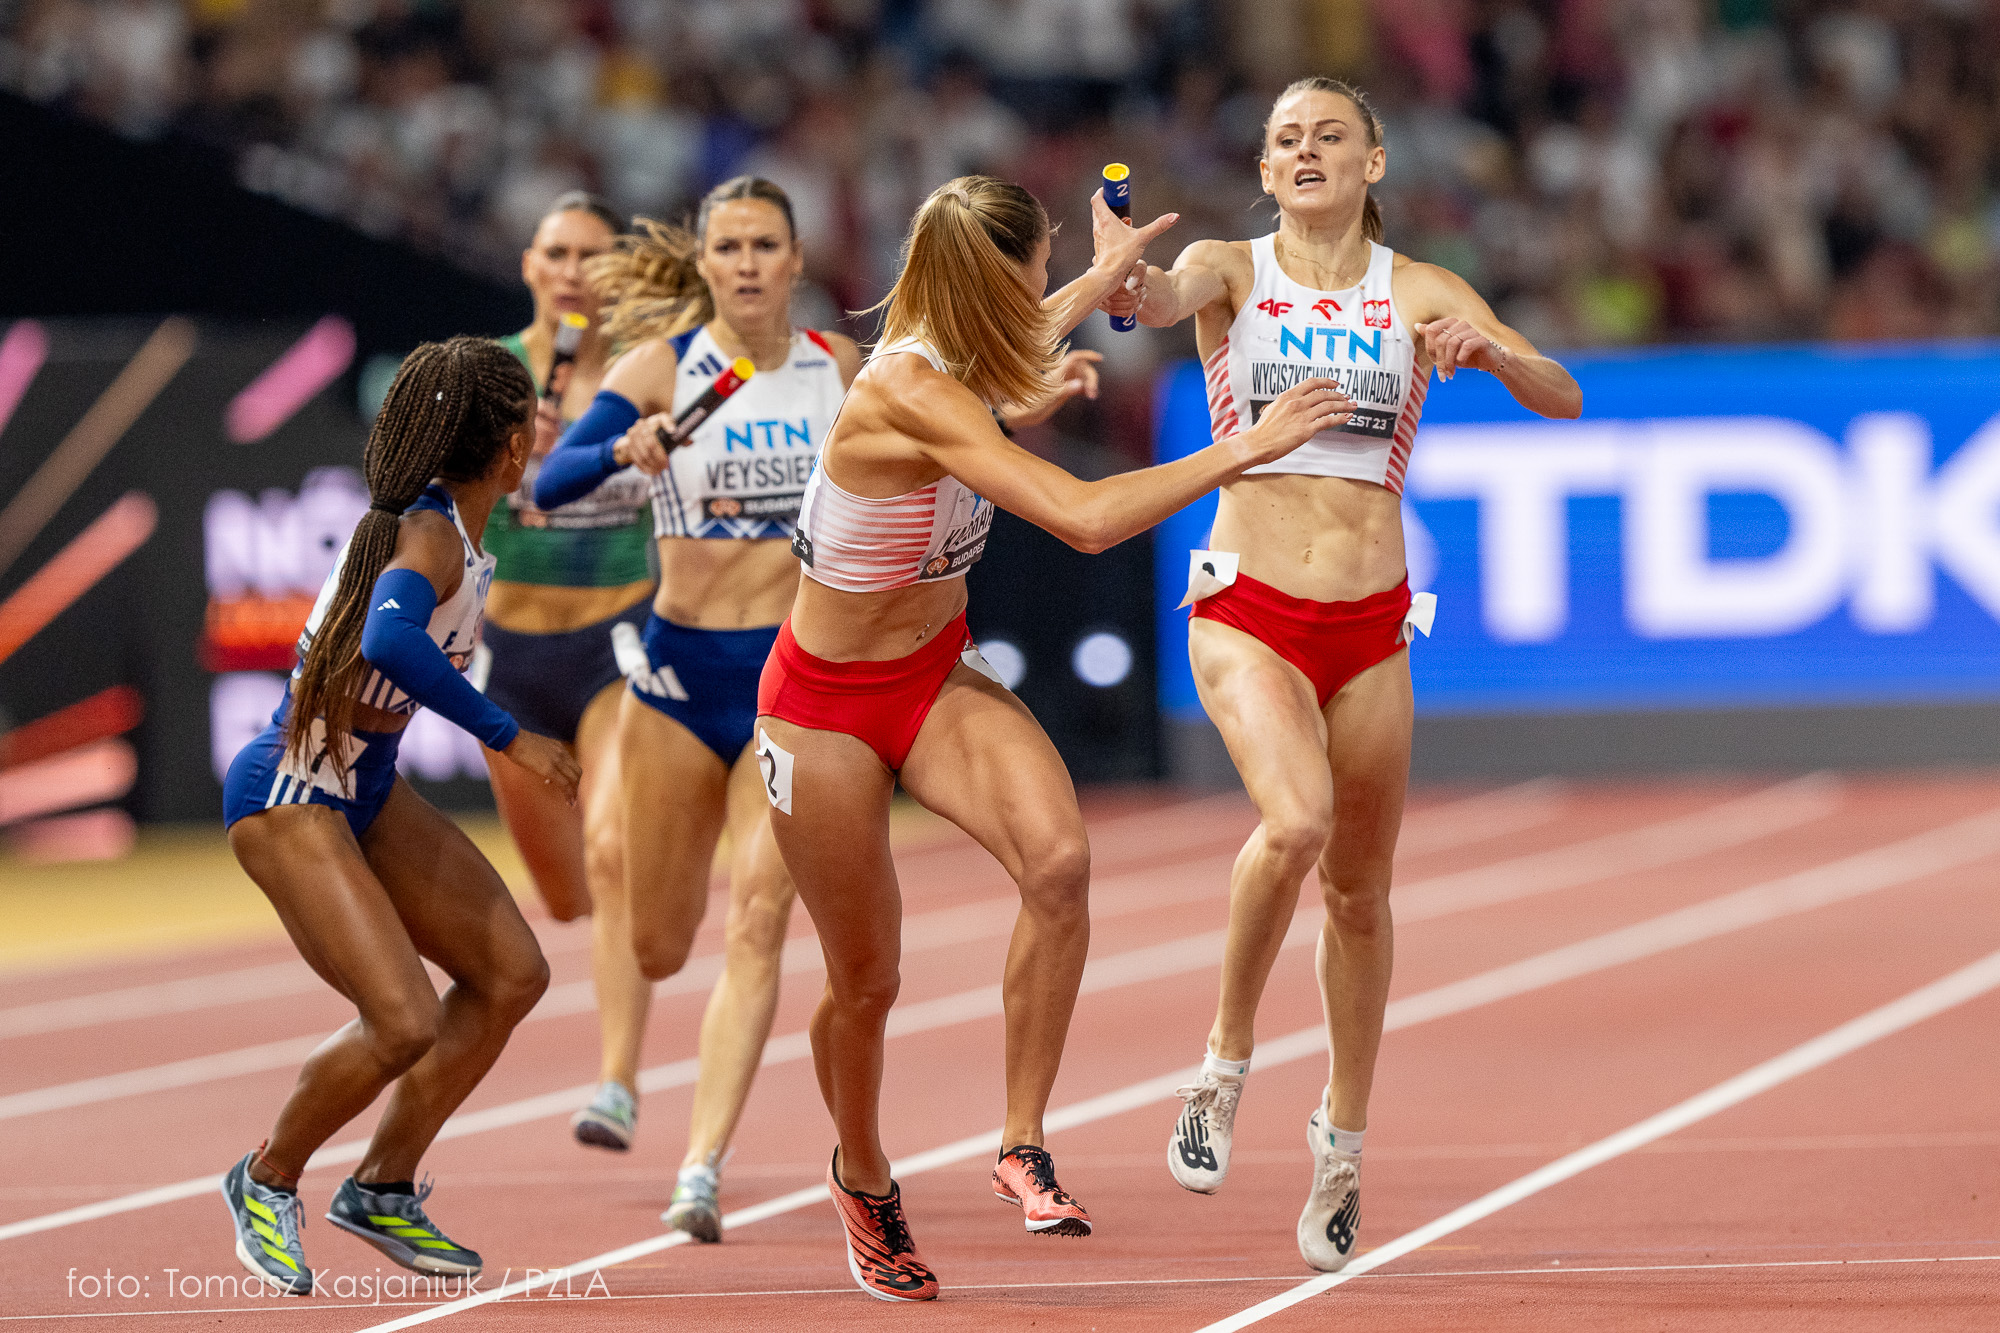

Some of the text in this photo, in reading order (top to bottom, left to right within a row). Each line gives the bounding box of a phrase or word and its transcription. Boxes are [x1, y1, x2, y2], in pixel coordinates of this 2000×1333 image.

[1116, 183, 1129, 197] 2
[1280, 324, 1382, 365] NTN
[724, 416, 812, 453] NTN
[1372, 417, 1388, 431] 23
[1408, 412, 2000, 642] TDK
[763, 747, 778, 800] 2
